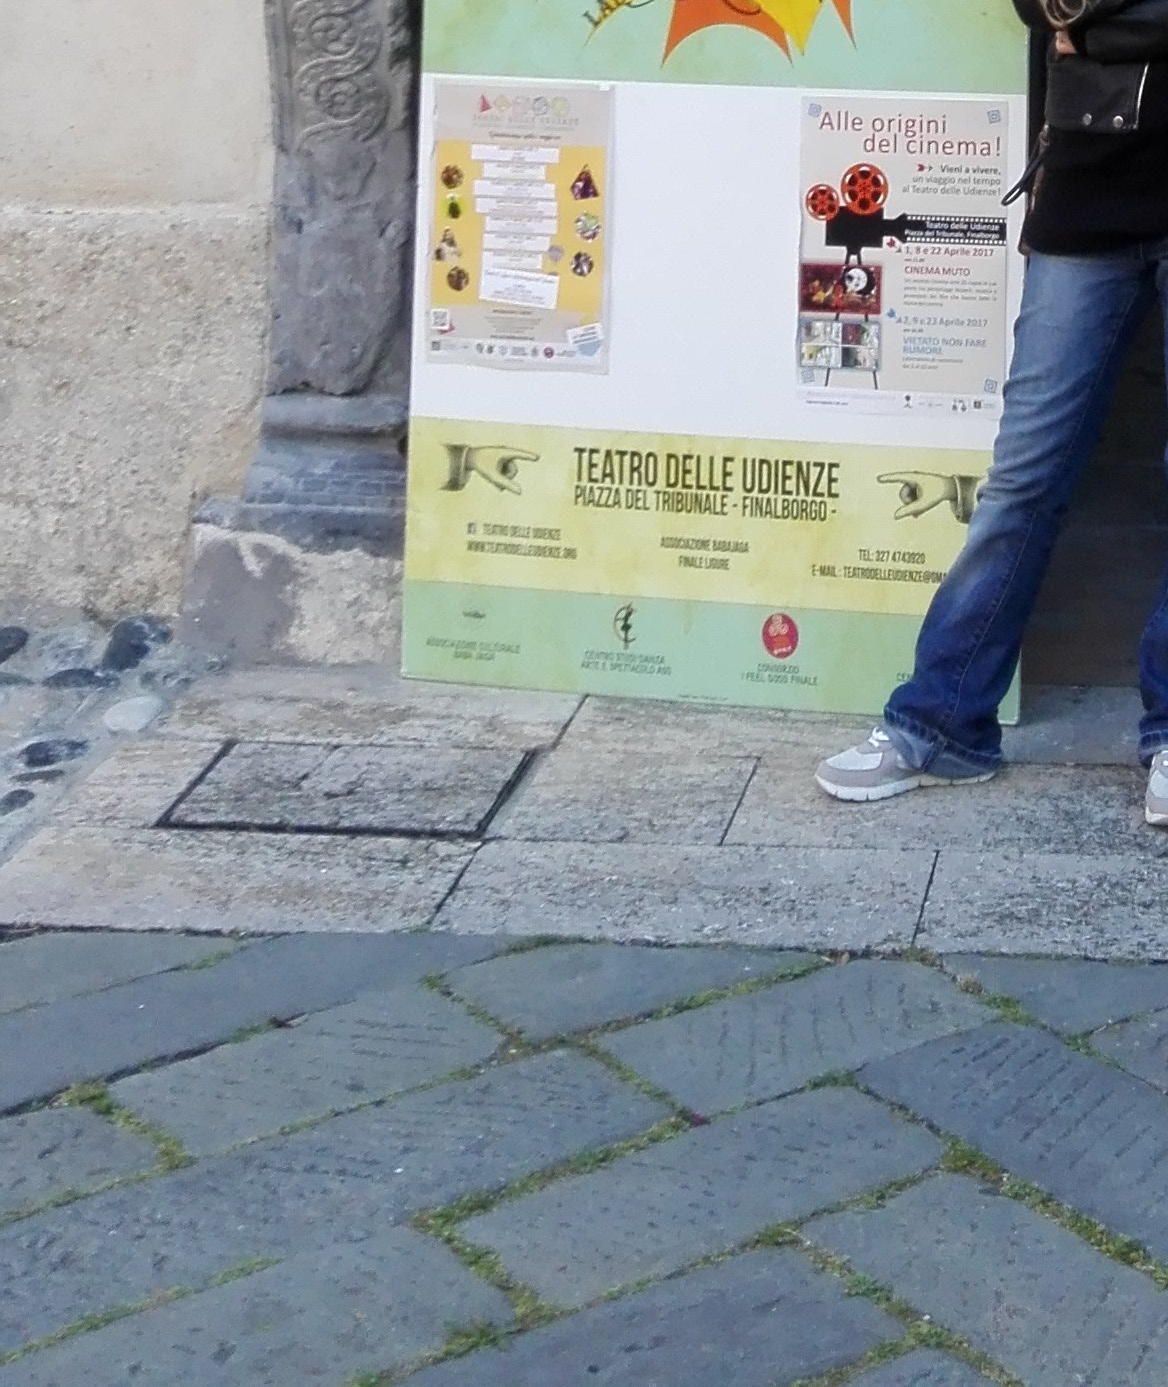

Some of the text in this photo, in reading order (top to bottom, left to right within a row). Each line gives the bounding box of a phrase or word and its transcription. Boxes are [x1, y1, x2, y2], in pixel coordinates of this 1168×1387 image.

[818, 109, 947, 138] Alle origini
[863, 133, 1001, 157] del cinema!
[940, 164, 963, 174] Vieni
[964, 166, 970, 174] a
[926, 176, 956, 186] viaggio
[957, 176, 971, 184] nel
[972, 177, 1001, 187] tempo
[912, 185, 938, 194] Teatro
[940, 186, 961, 195] delle
[925, 221, 1000, 231] Teatro delle Udienze
[904, 228, 923, 237] Piazza
[924, 229, 935, 237] del
[922, 247, 929, 255] e
[931, 247, 941, 255] 22
[943, 247, 970, 257] Aprile
[972, 248, 994, 257] 2017
[904, 265, 971, 277] CINEMA MUTO
[938, 317, 965, 327] Aprile
[573, 446, 841, 499] TEATRO DELLE UDIENZE
[573, 485, 622, 508] PIAZZA
[625, 487, 650, 511] DEL
[653, 489, 729, 516] TRIBUNALE
[741, 495, 828, 522] FINALBORGO
[875, 549, 890, 563] 327
